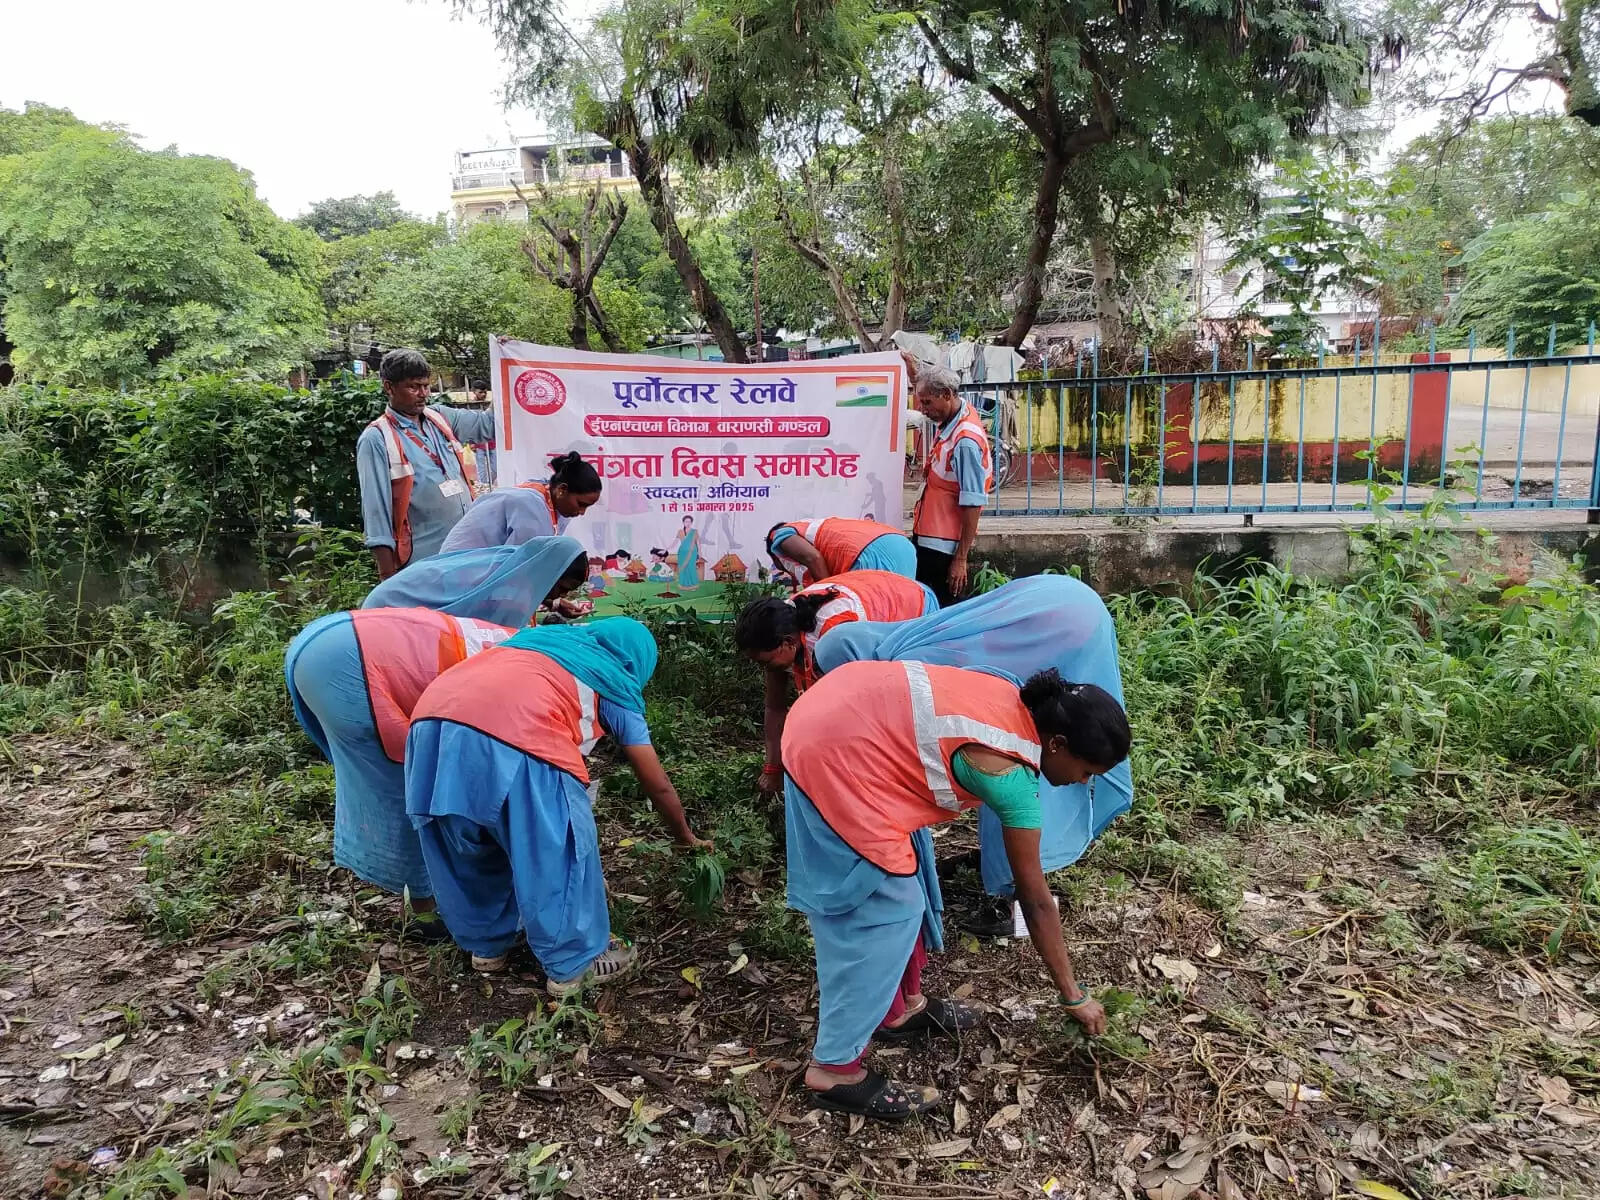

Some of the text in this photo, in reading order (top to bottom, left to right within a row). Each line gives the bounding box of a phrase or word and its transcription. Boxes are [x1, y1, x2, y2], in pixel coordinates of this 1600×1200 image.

[612, 376, 798, 408] पूर्वोत्तर रेलवे
[591, 416, 664, 433] ईएनएचएम
[717, 417, 775, 434] वाराणसी
[777, 421, 822, 433] मण्डल
[671, 446, 748, 478] दिवस
[753, 447, 861, 479] समारोह
[661, 500, 755, 513] 1 से 15 अगस्त 2025
